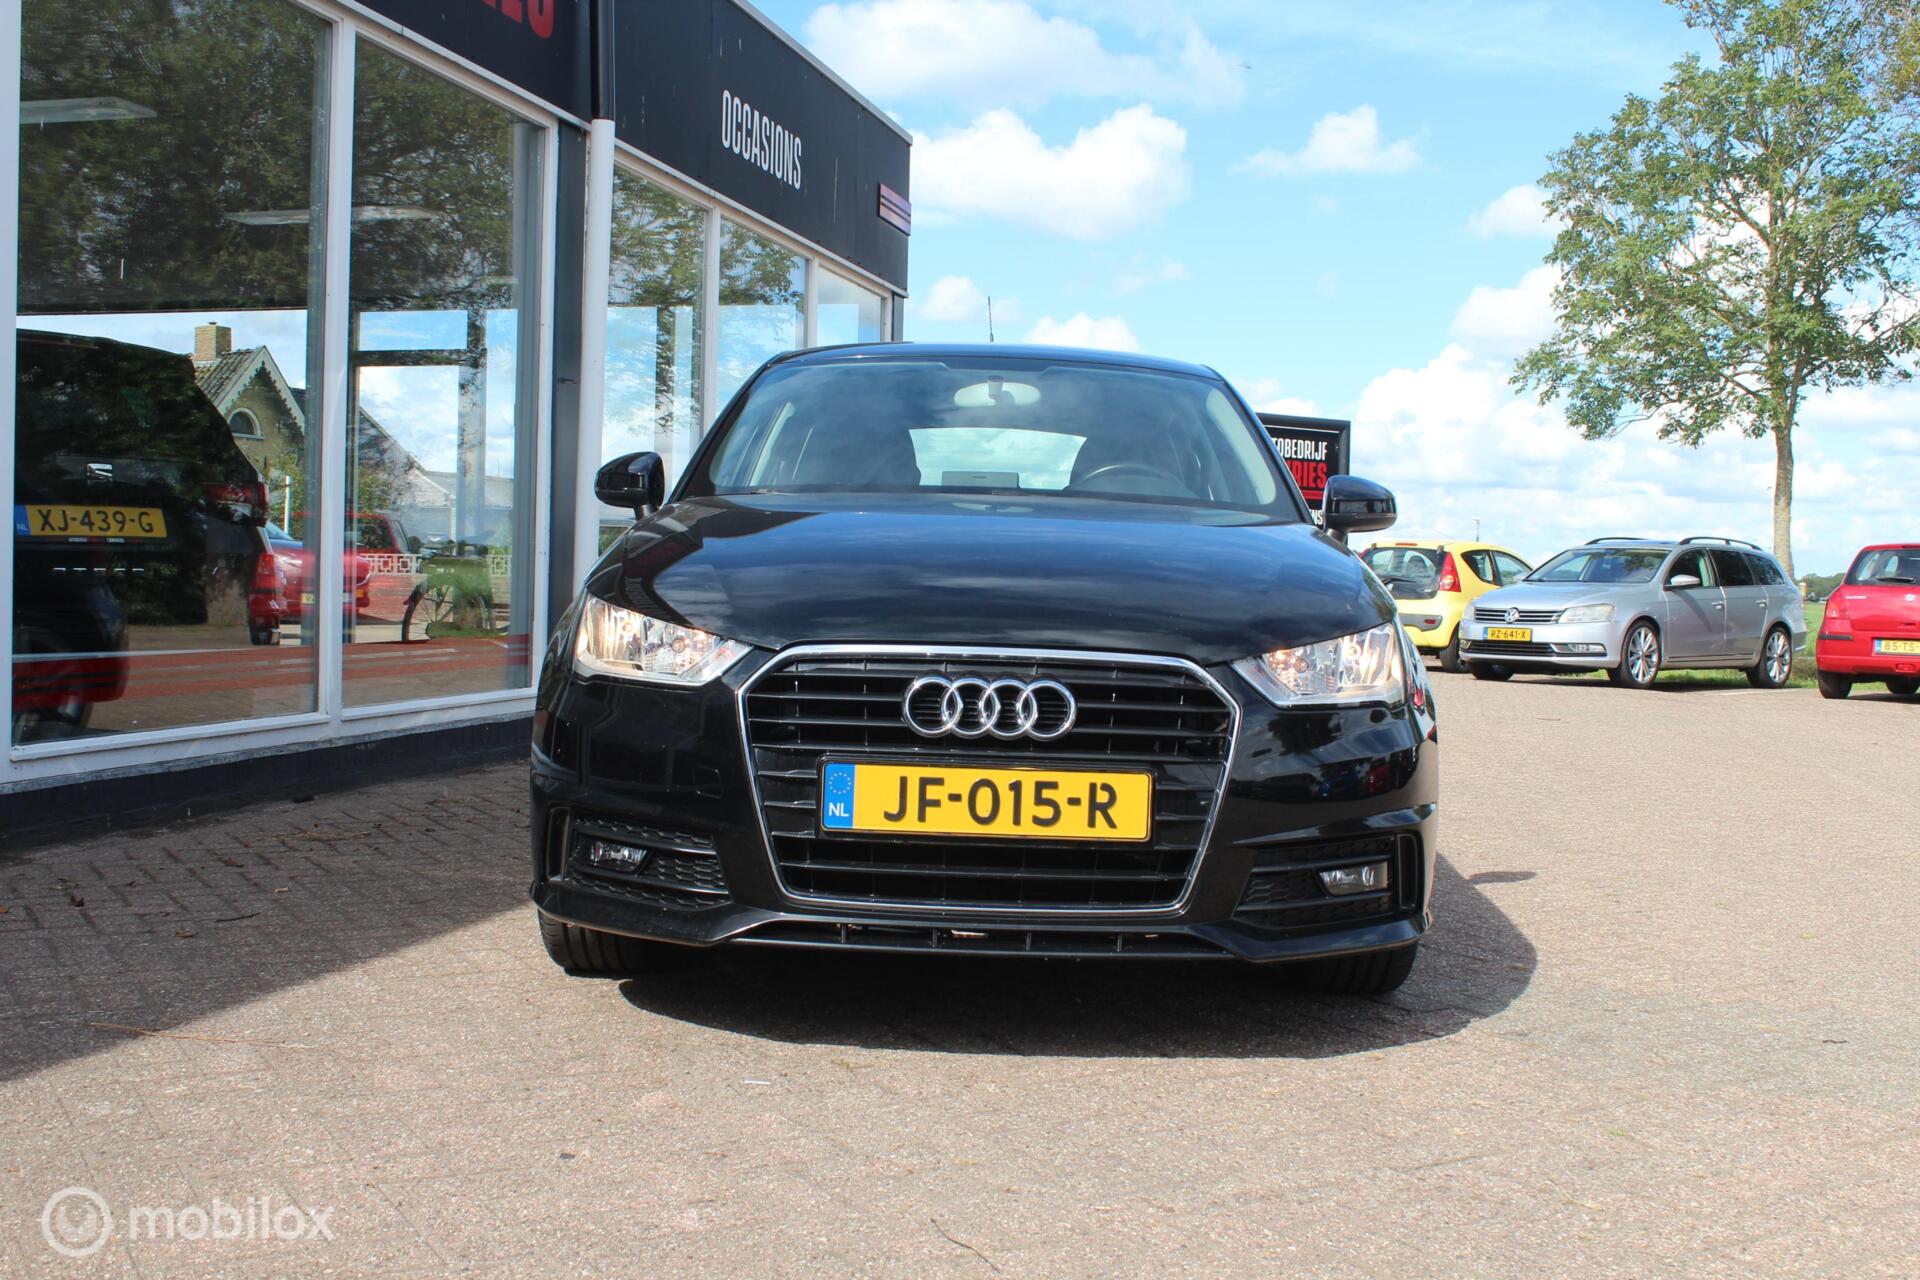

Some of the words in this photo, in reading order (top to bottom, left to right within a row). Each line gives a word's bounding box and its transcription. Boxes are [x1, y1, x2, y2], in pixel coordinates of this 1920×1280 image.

[722, 89, 802, 190] OCCASIONS
[1285, 460, 1328, 488] RIES
[37, 509, 154, 533] XJ-439-G
[1490, 629, 1526, 639] RZ-641-X
[828, 802, 849, 817] NL
[883, 775, 1118, 829] JF-015-R
